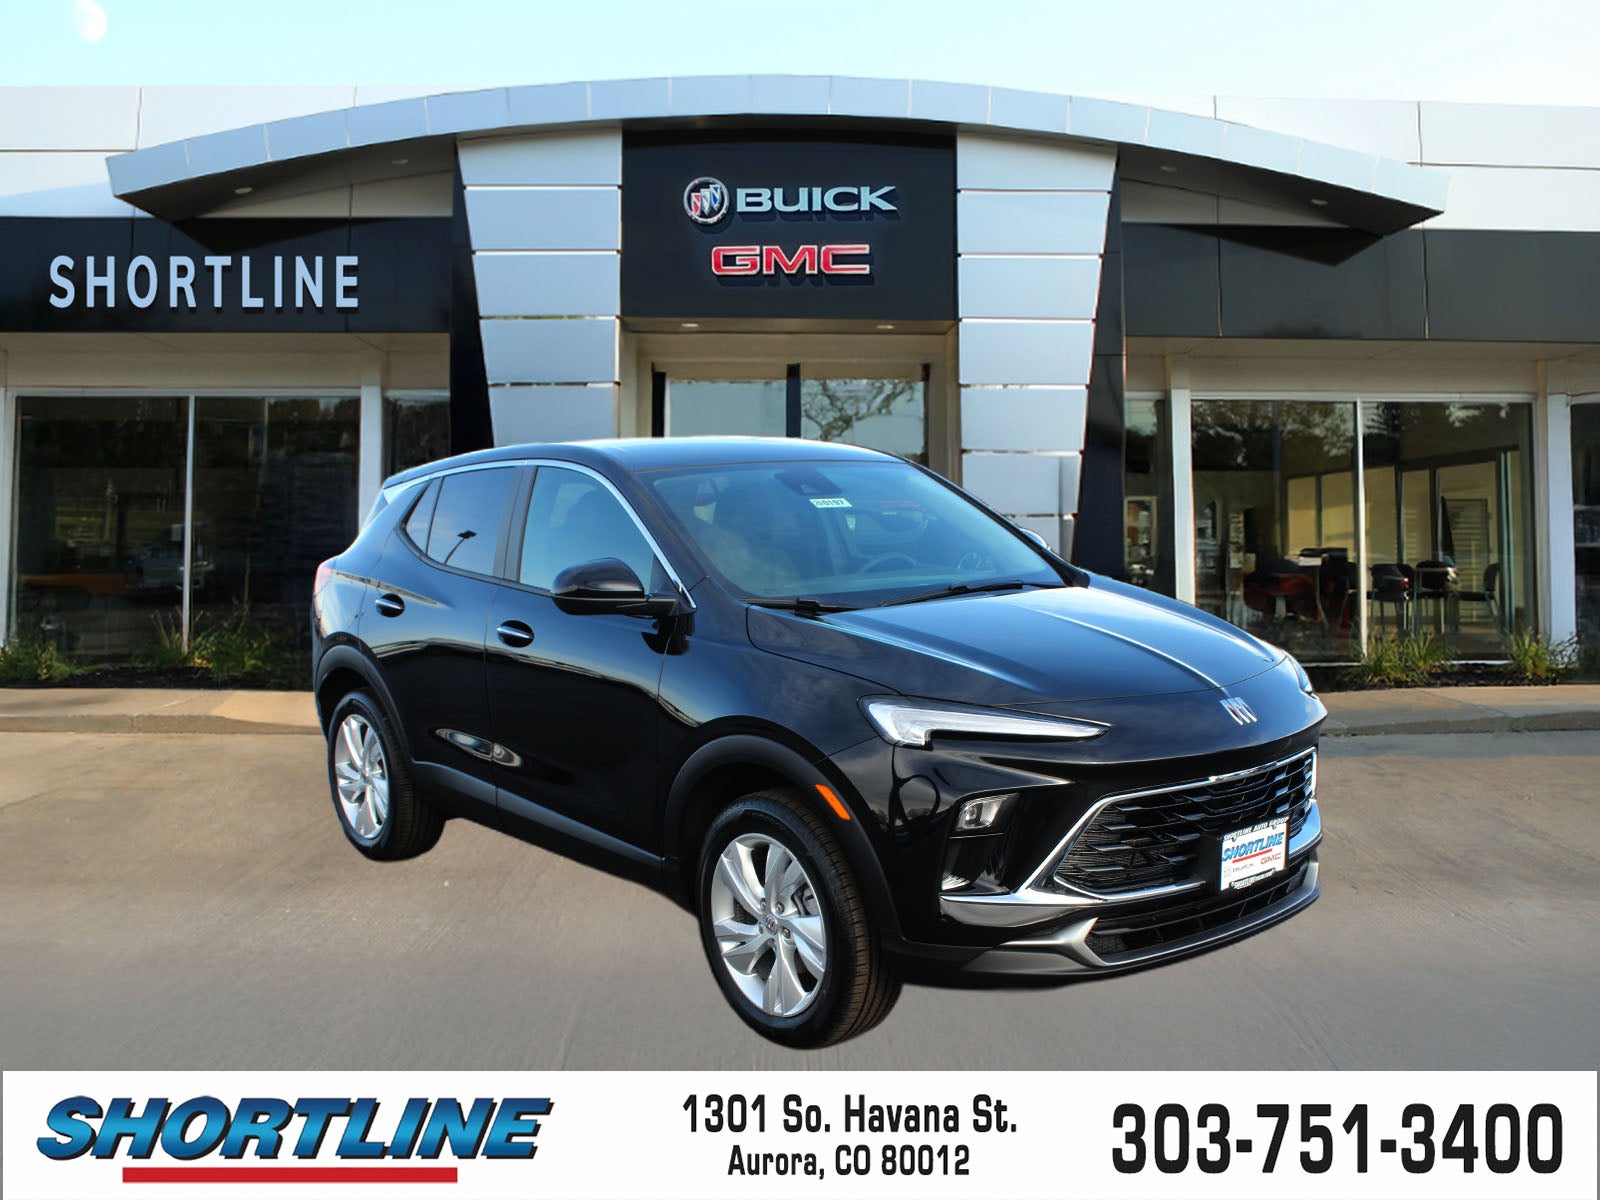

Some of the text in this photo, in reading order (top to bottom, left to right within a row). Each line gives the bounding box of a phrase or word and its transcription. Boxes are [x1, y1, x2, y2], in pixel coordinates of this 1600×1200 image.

[736, 186, 898, 213] BUICK
[711, 244, 870, 276] GMC
[49, 255, 360, 309] SHORTLINE
[1221, 831, 1285, 862] SHORTLINE
[1260, 852, 1282, 865] GMC
